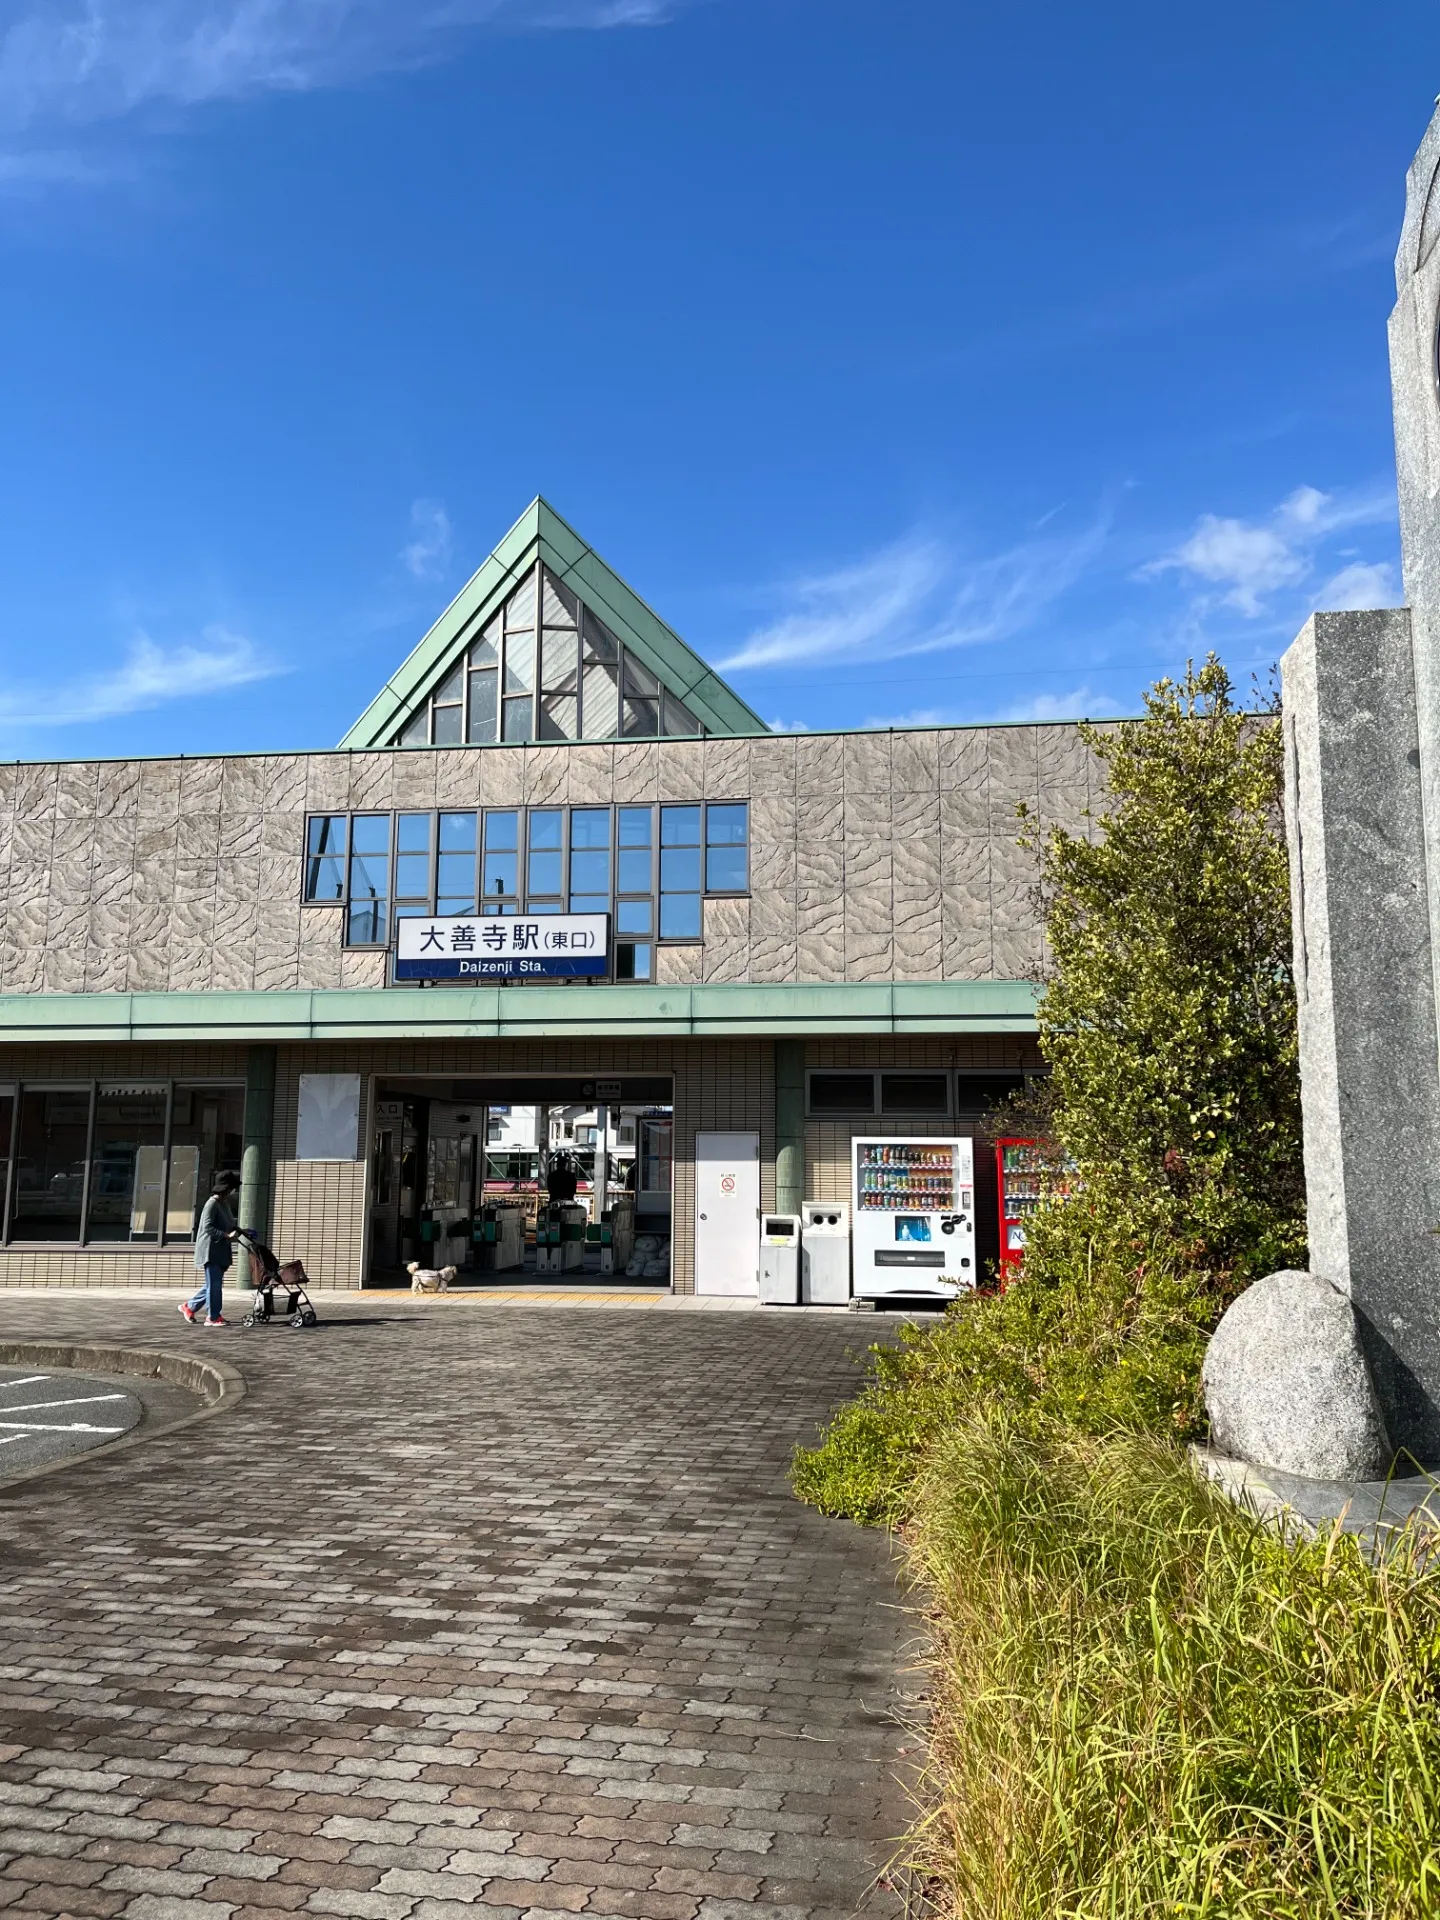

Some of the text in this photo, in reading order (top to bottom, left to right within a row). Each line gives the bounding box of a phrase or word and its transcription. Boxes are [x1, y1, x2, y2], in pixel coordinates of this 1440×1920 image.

[419, 924, 595, 952] 大善寺駅(東口)
[460, 960, 546, 974] Daizenji Sta.
[376, 1104, 398, 1114] 入口
